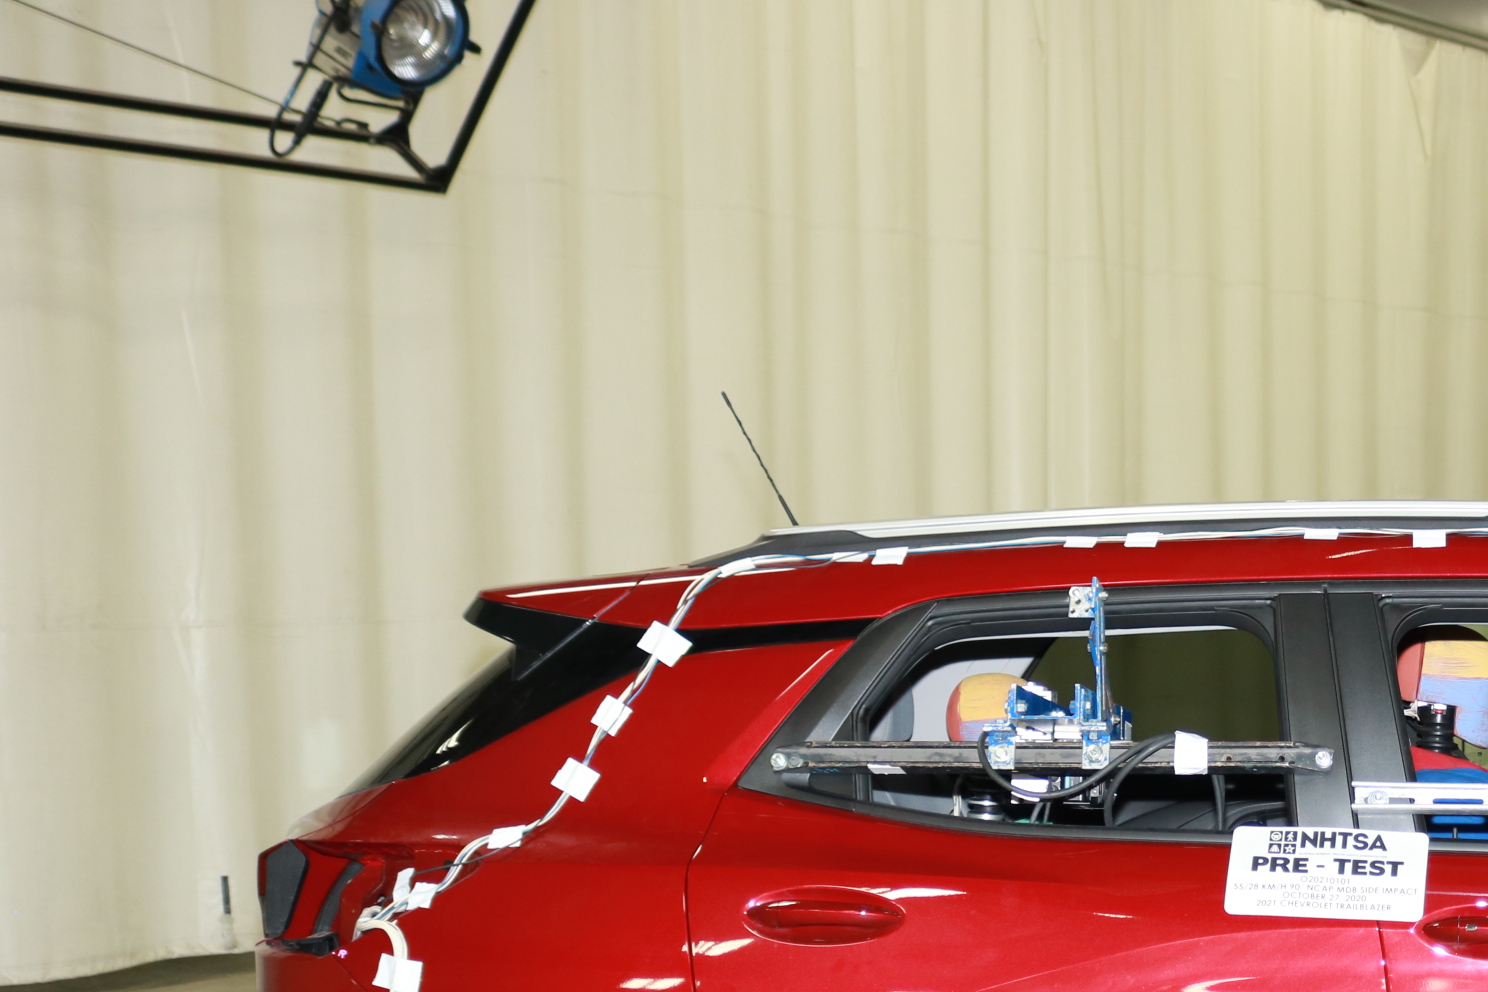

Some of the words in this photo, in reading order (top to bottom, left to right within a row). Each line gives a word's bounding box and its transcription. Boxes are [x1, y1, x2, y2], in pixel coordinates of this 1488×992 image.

[1300, 831, 1388, 852] NHTSA
[1251, 855, 1309, 873] PRE
[1333, 858, 1405, 877] TEST
[1233, 883, 1259, 891] 55/28
[1261, 883, 1287, 891] KM/H
[1306, 884, 1334, 892] NCAP
[1336, 886, 1357, 894] MDB
[1382, 887, 1418, 896] IMPACT
[1282, 891, 1326, 901] OCTOBER
[1345, 894, 1367, 903] 2020
[1256, 899, 1276, 907] 2021
[1280, 900, 1333, 909] CHEVROLET
[1336, 902, 1392, 912] TRAILBLAZER
